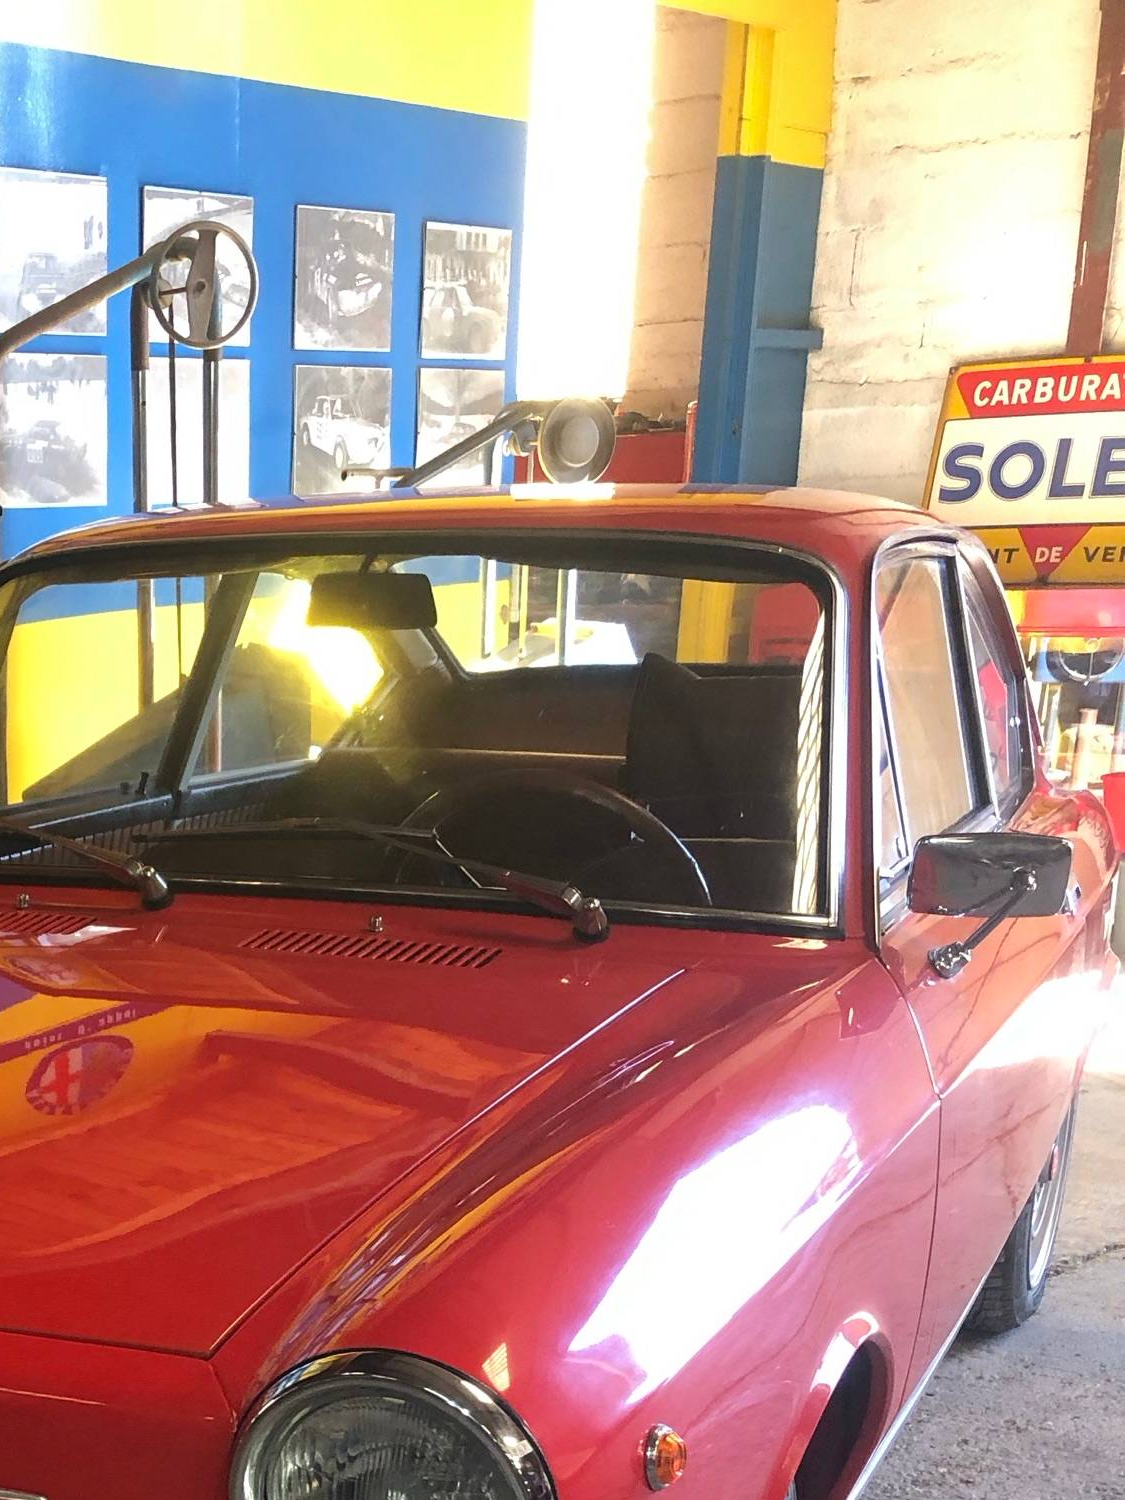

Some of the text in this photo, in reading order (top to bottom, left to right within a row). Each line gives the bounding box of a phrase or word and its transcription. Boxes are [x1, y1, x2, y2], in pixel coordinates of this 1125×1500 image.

[973, 372, 1125, 407] CARBURA
[938, 436, 1125, 504] SOLE
[1035, 546, 1063, 563] DE
[1083, 546, 1125, 562] VE
